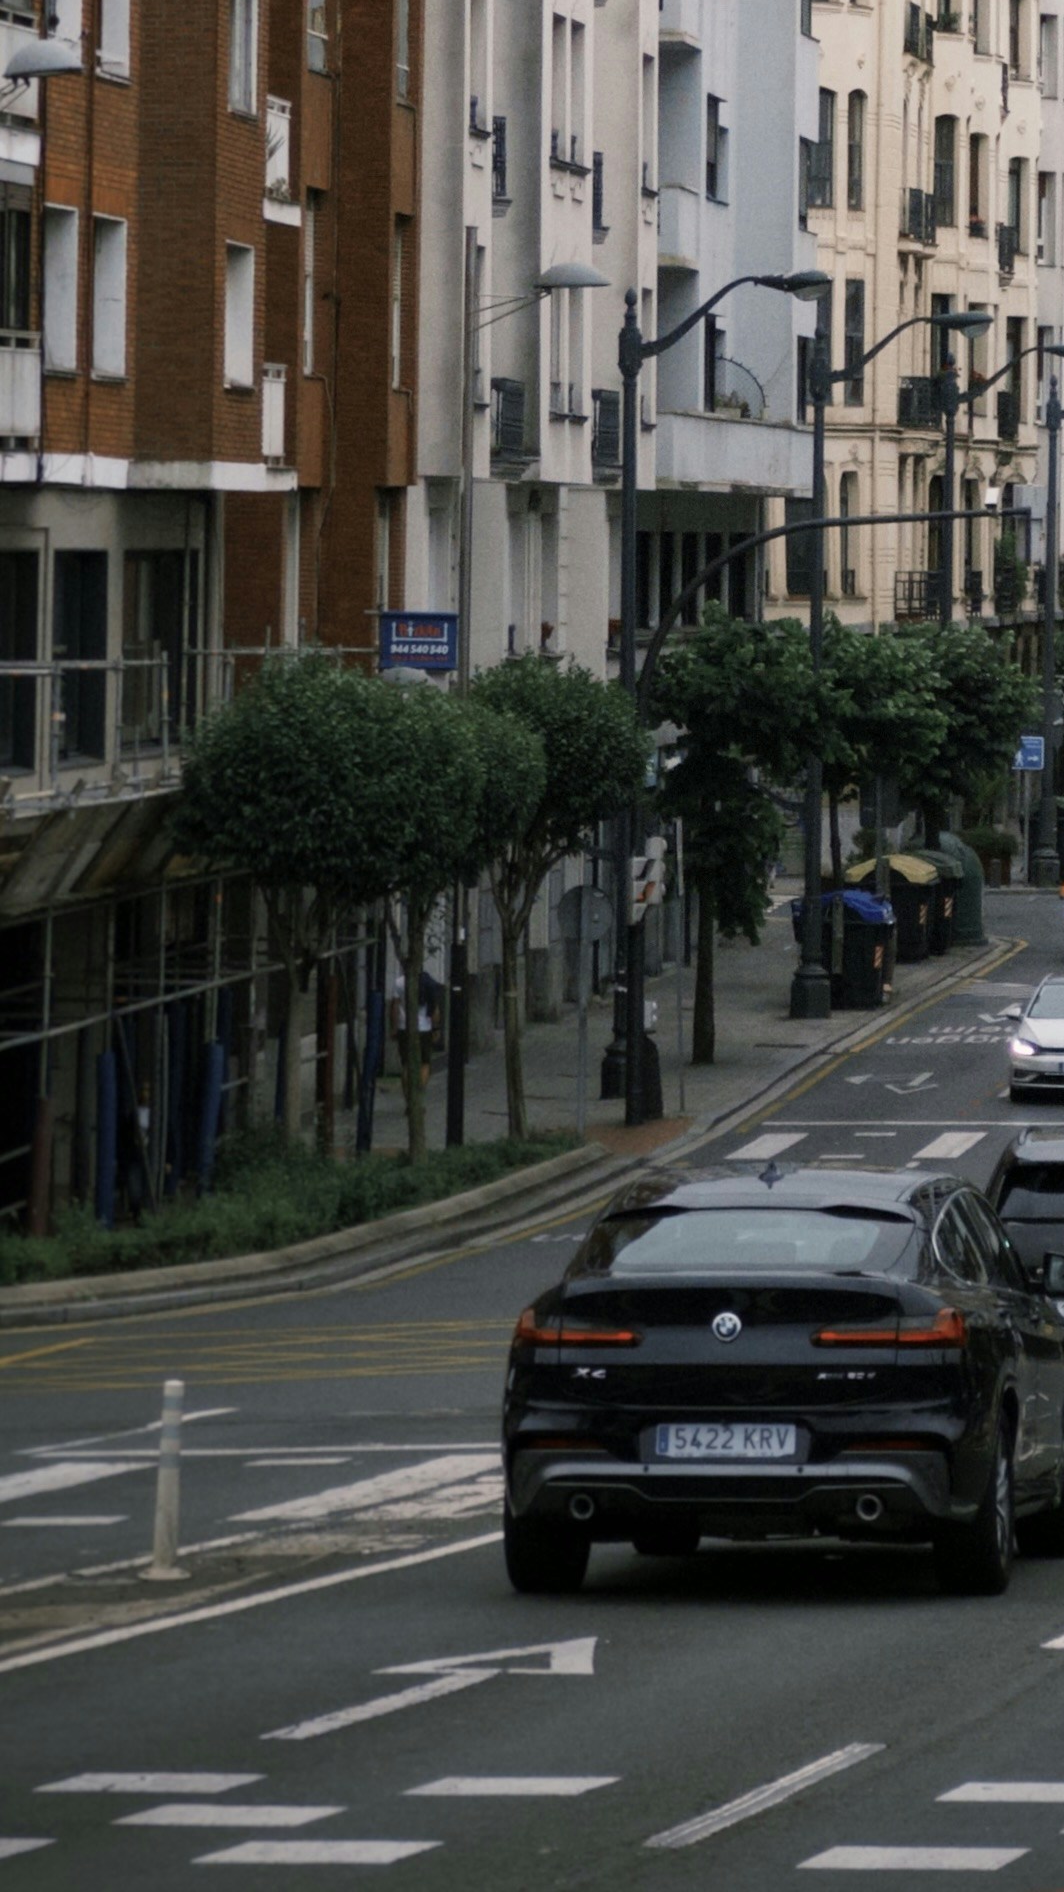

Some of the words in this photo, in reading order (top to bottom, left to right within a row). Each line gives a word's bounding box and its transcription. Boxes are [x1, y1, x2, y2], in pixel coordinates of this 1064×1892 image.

[390, 644, 409, 654] 944
[410, 644, 429, 654] 540
[429, 644, 449, 655] 540
[674, 1427, 734, 1450] 5422
[743, 1427, 790, 1450] KRV
